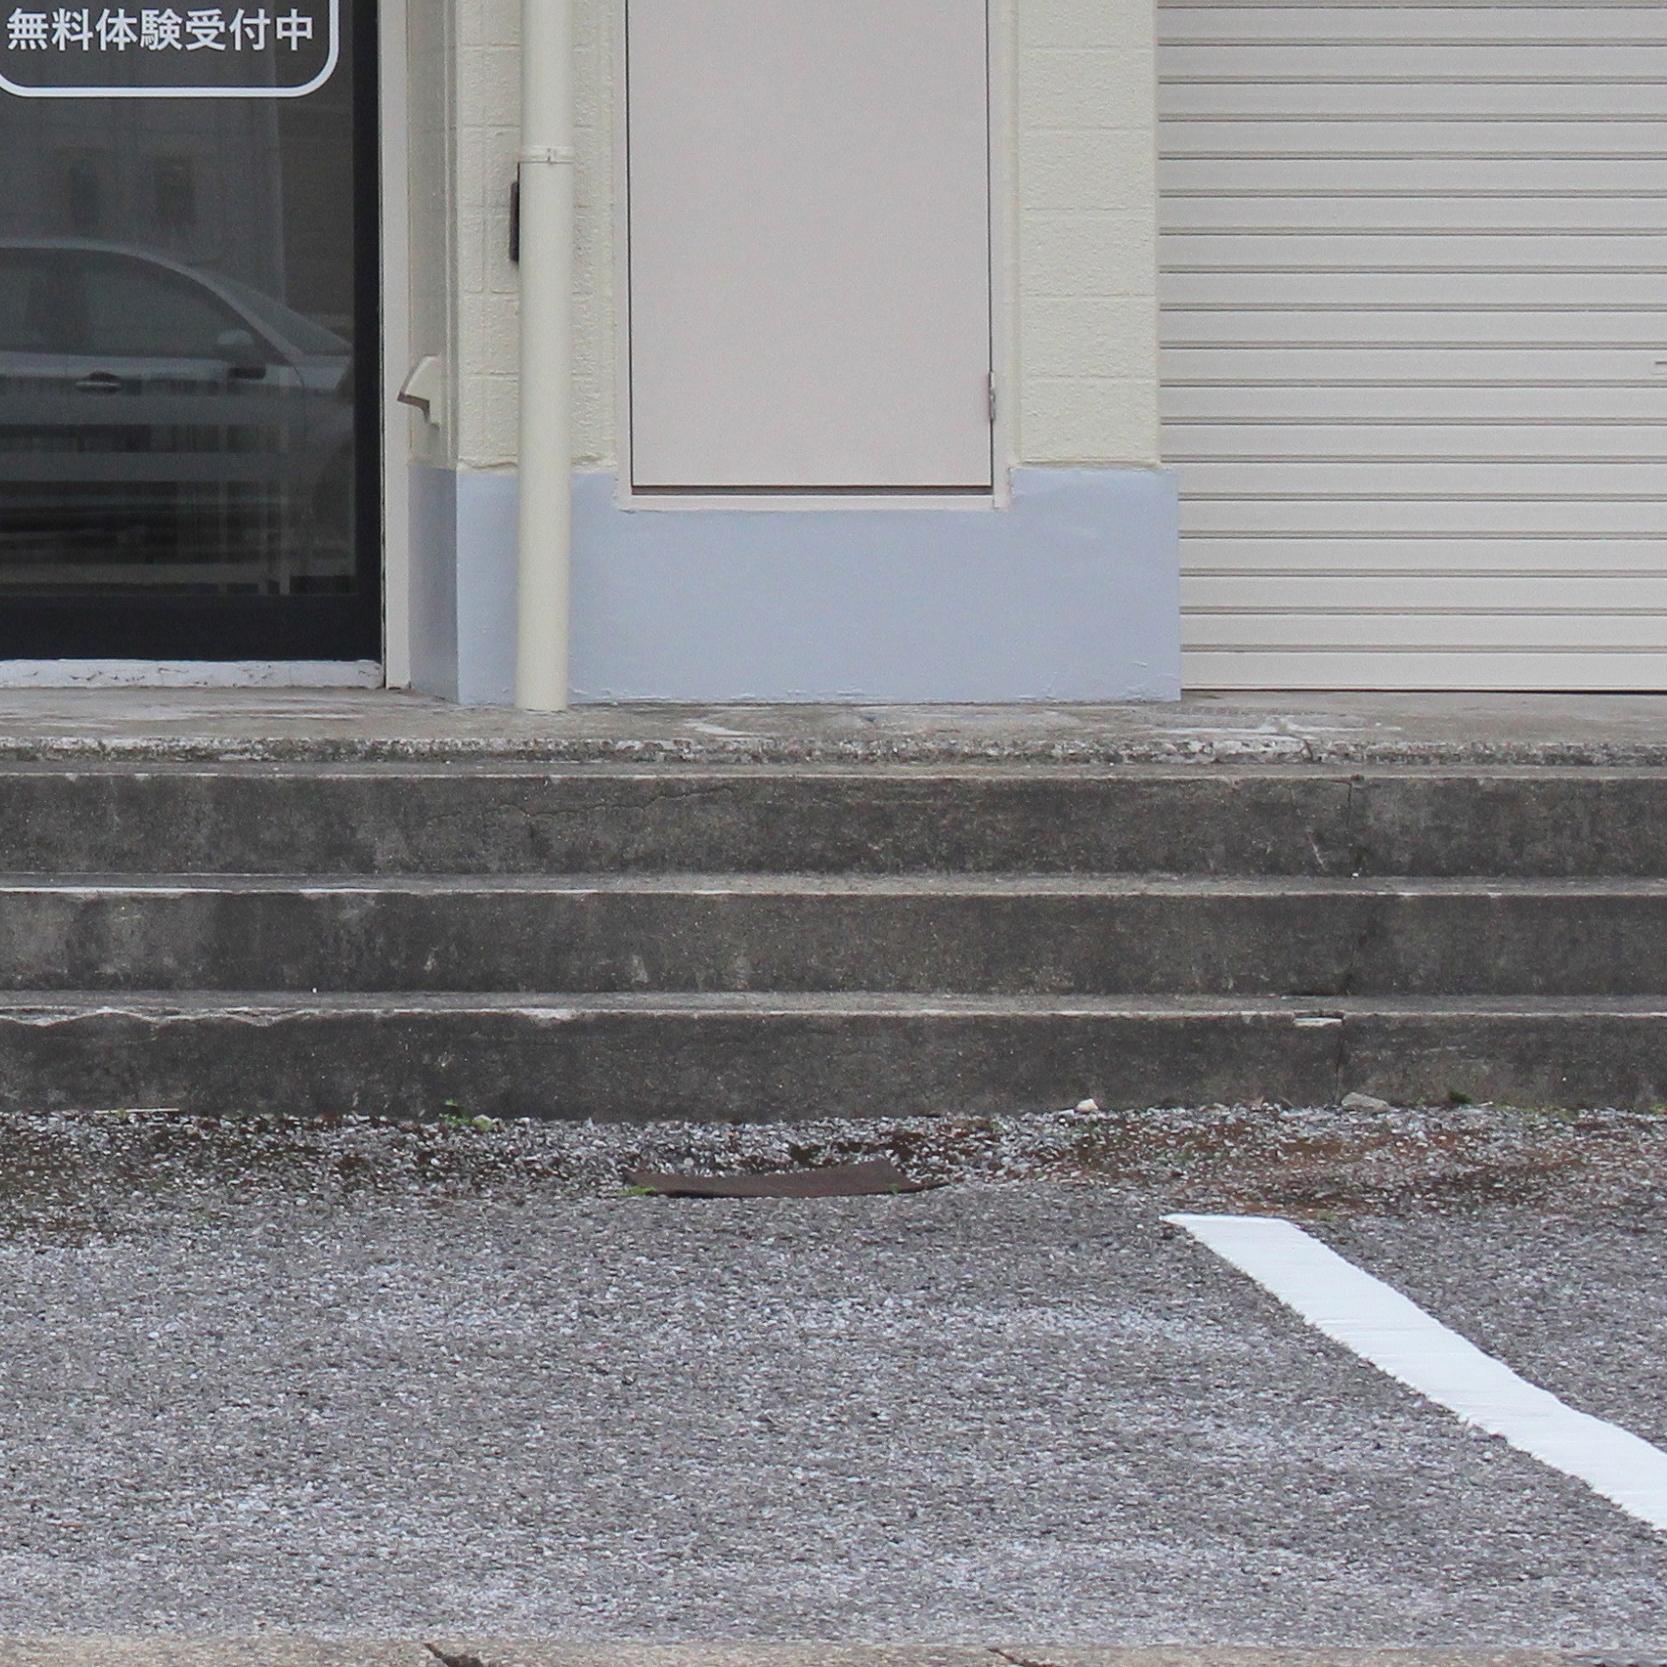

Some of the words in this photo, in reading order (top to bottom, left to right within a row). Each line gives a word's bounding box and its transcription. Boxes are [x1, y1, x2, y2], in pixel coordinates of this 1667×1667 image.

[6, 7, 314, 52] 無料体験受付中
